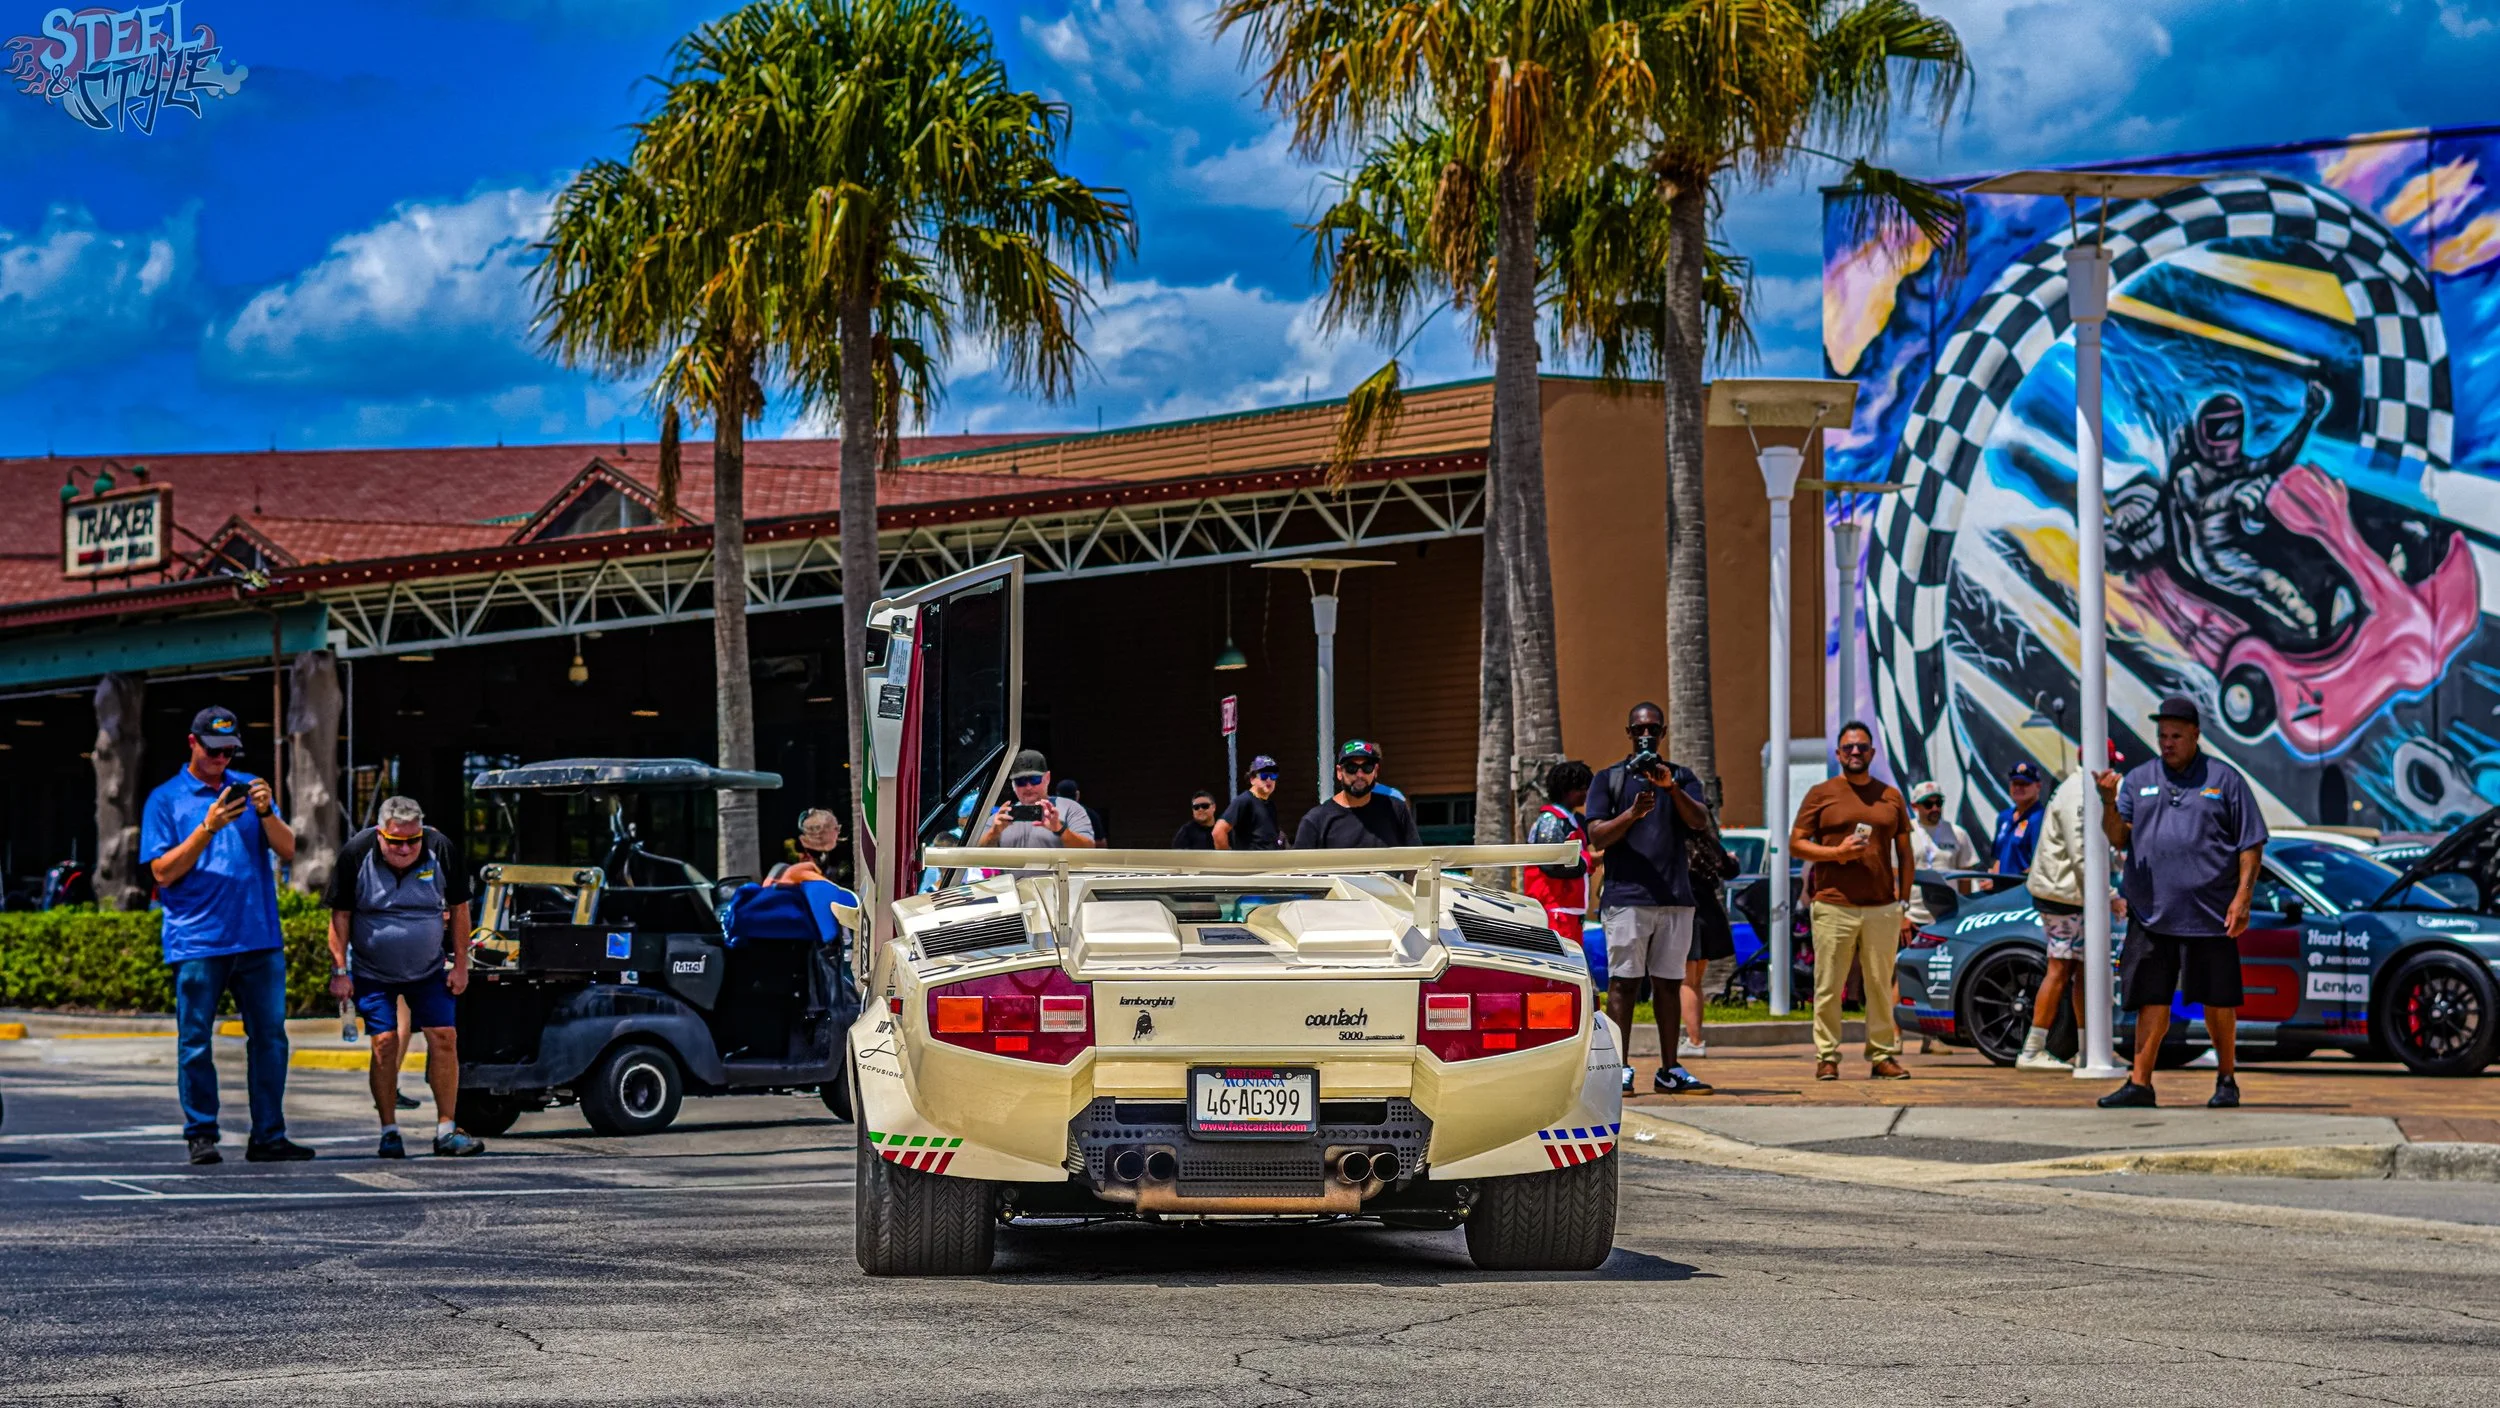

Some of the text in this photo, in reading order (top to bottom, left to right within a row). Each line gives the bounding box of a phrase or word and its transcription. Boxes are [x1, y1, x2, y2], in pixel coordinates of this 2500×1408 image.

[77, 500, 154, 546] TRACKER
[1954, 907, 2033, 935] Hard
[2313, 977, 2363, 994] Lenvo
[1119, 996, 1176, 1008] lamborghini
[1304, 1007, 1368, 1027] countach
[1338, 1031, 1364, 1041] 5000
[858, 1062, 905, 1080] TECFUSIONS
[1586, 1062, 1622, 1072] CFUSIONS
[1222, 1078, 1285, 1088] MONTANA
[1199, 1121, 1308, 1132] www.fastcarsltd.com
